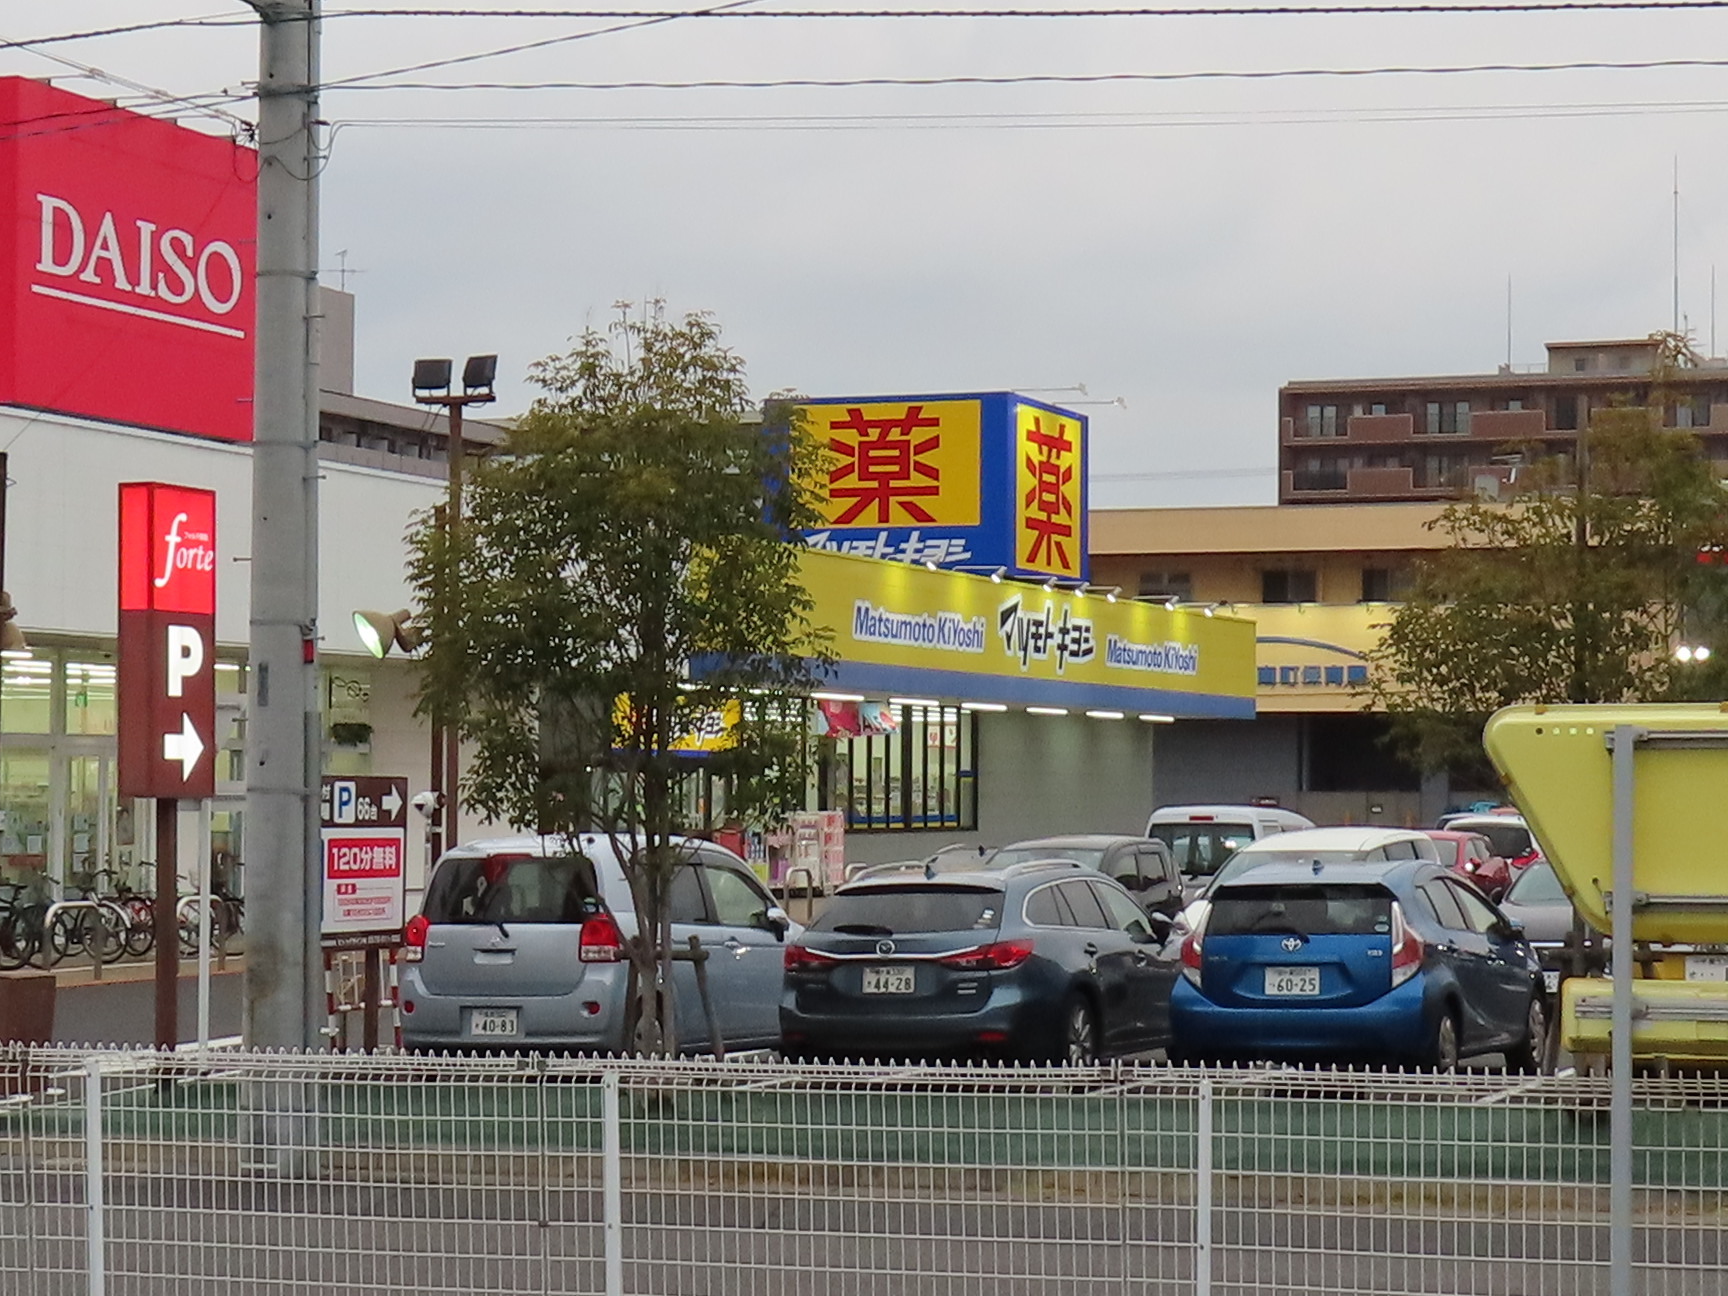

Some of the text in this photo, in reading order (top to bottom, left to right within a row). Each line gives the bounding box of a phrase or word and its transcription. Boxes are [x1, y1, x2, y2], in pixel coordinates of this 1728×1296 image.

[35, 192, 243, 315] DAISO
[829, 405, 941, 524] 薬
[1025, 415, 1073, 570] 薬
[154, 512, 214, 588] forte
[167, 624, 204, 698] P
[855, 606, 985, 648] Matsumoto KiYoshi
[999, 600, 1094, 671] マツモトキヨシ
[1107, 638, 1198, 672] Matsumoto KiYoshi
[338, 786, 352, 819] P
[332, 845, 397, 872] 120分無料
